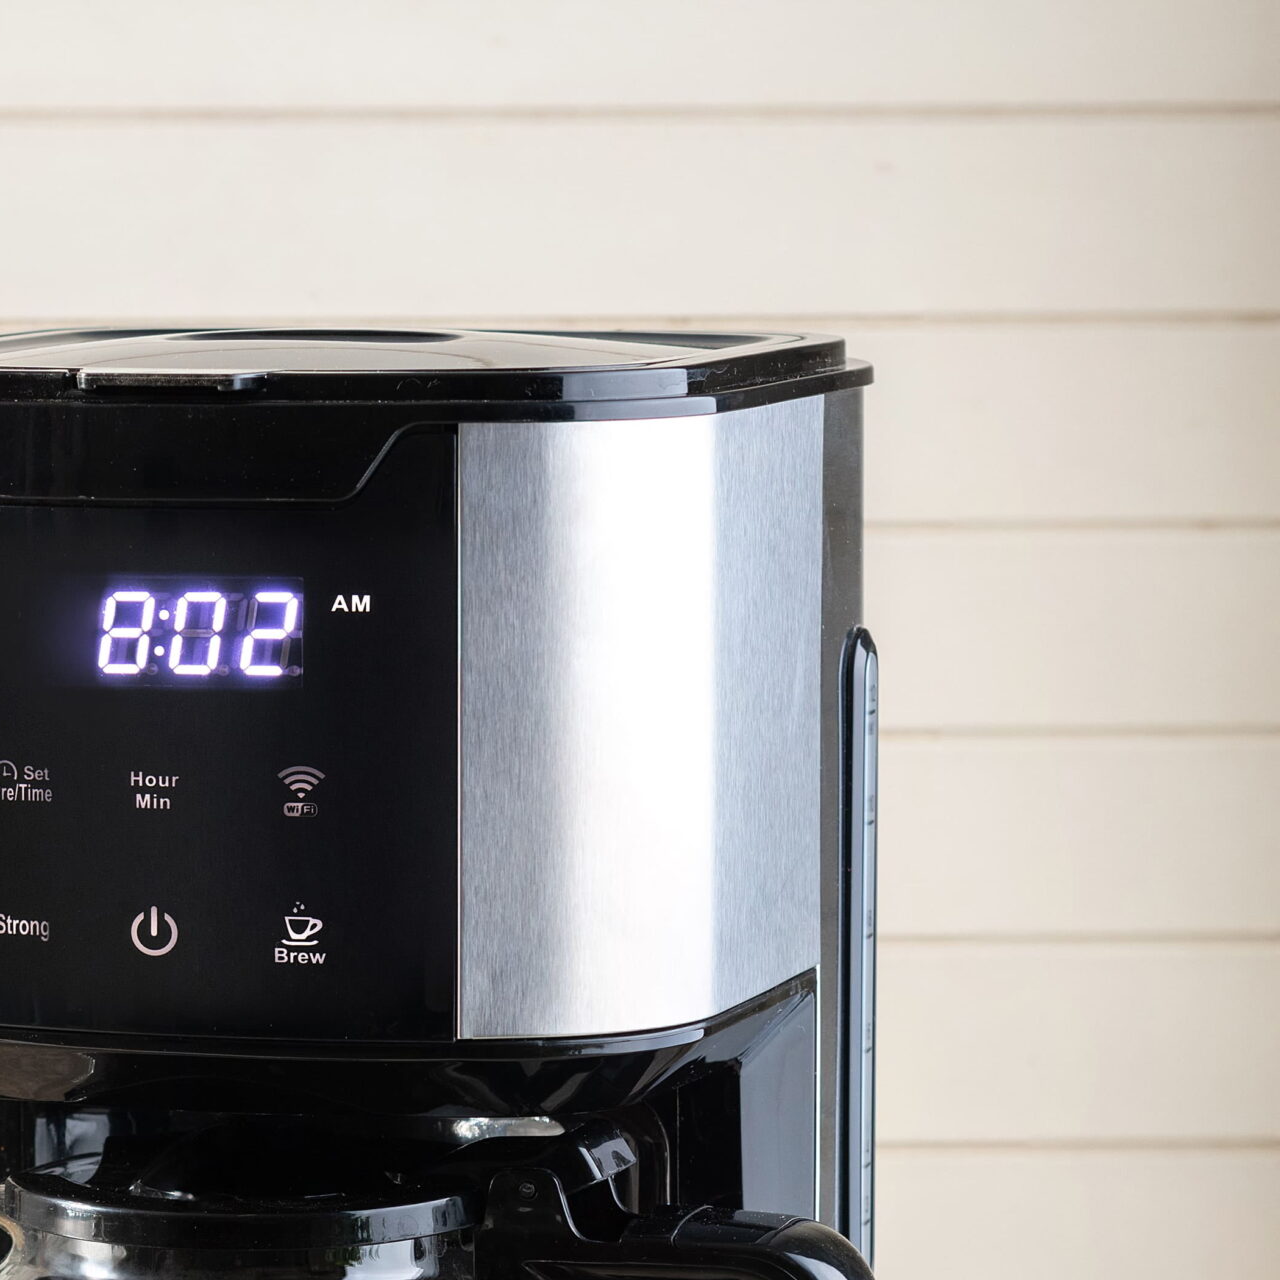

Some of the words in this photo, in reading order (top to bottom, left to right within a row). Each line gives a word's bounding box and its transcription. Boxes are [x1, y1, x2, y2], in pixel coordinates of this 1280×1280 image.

[330, 594, 372, 613] AM
[97, 590, 299, 676] 8:02
[23, 765, 50, 781] Set
[129, 770, 180, 788] Hour
[135, 793, 172, 810] Min
[273, 947, 327, 965] Brew
